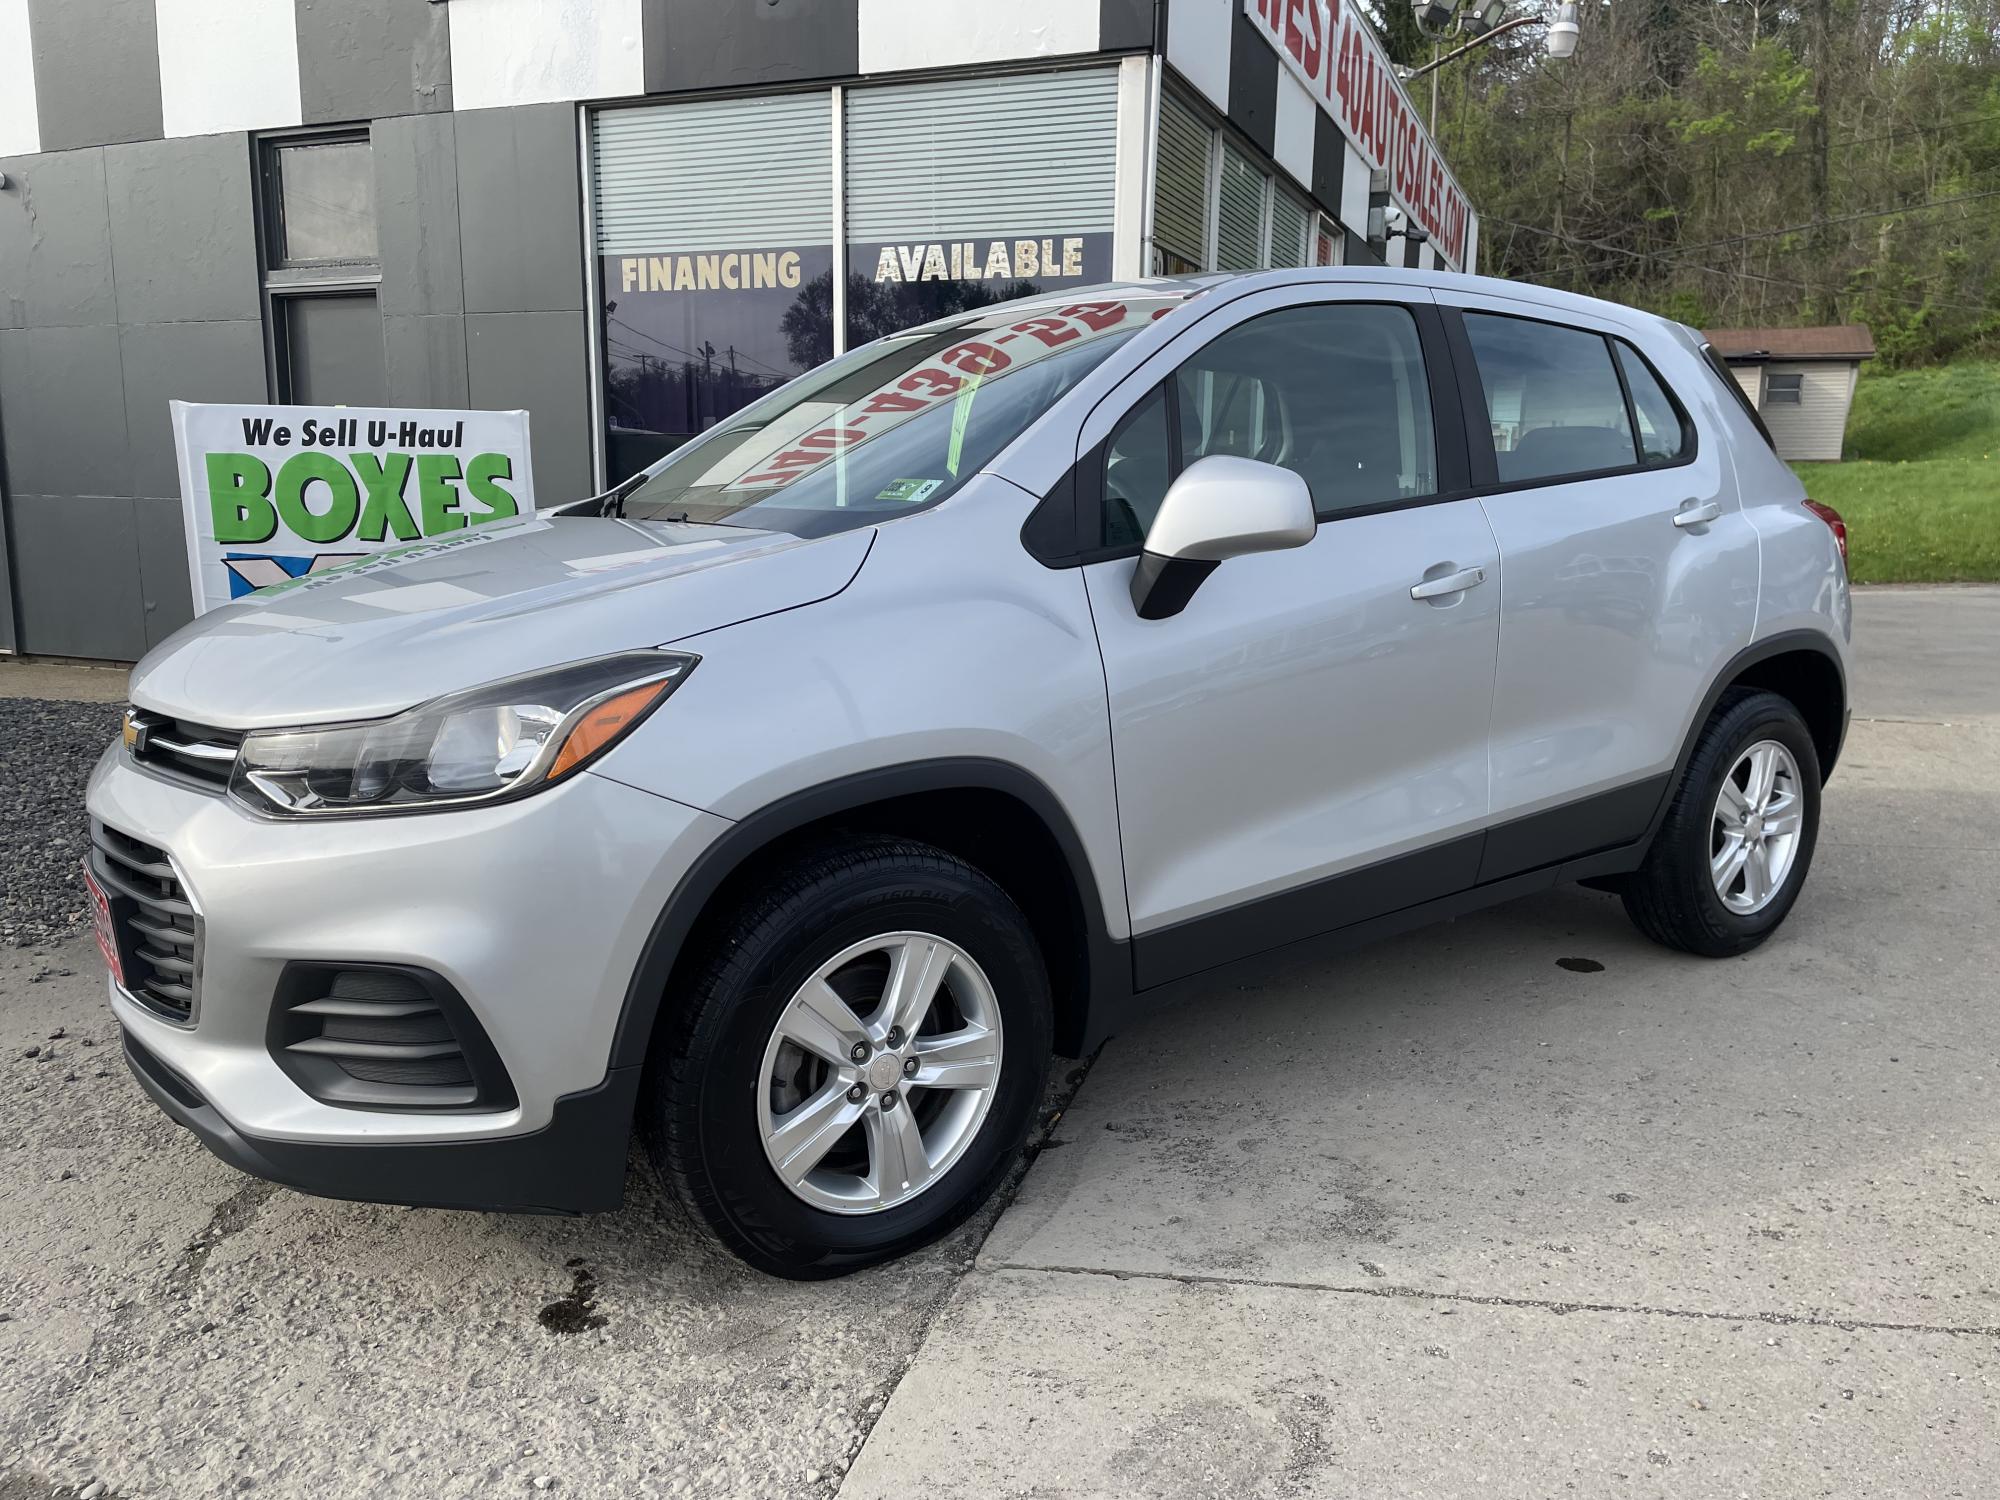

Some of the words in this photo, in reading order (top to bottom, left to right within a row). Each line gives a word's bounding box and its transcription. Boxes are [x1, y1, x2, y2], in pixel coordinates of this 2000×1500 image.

[1257, 0, 1465, 268] EST40AUTOSALES.COM
[621, 251, 801, 293] FINANCING
[874, 237, 1084, 283] AVAILABLE
[242, 418, 291, 446] We
[301, 419, 357, 447] Sell
[367, 420, 464, 448] U-Haul
[205, 451, 520, 544] BOXES
